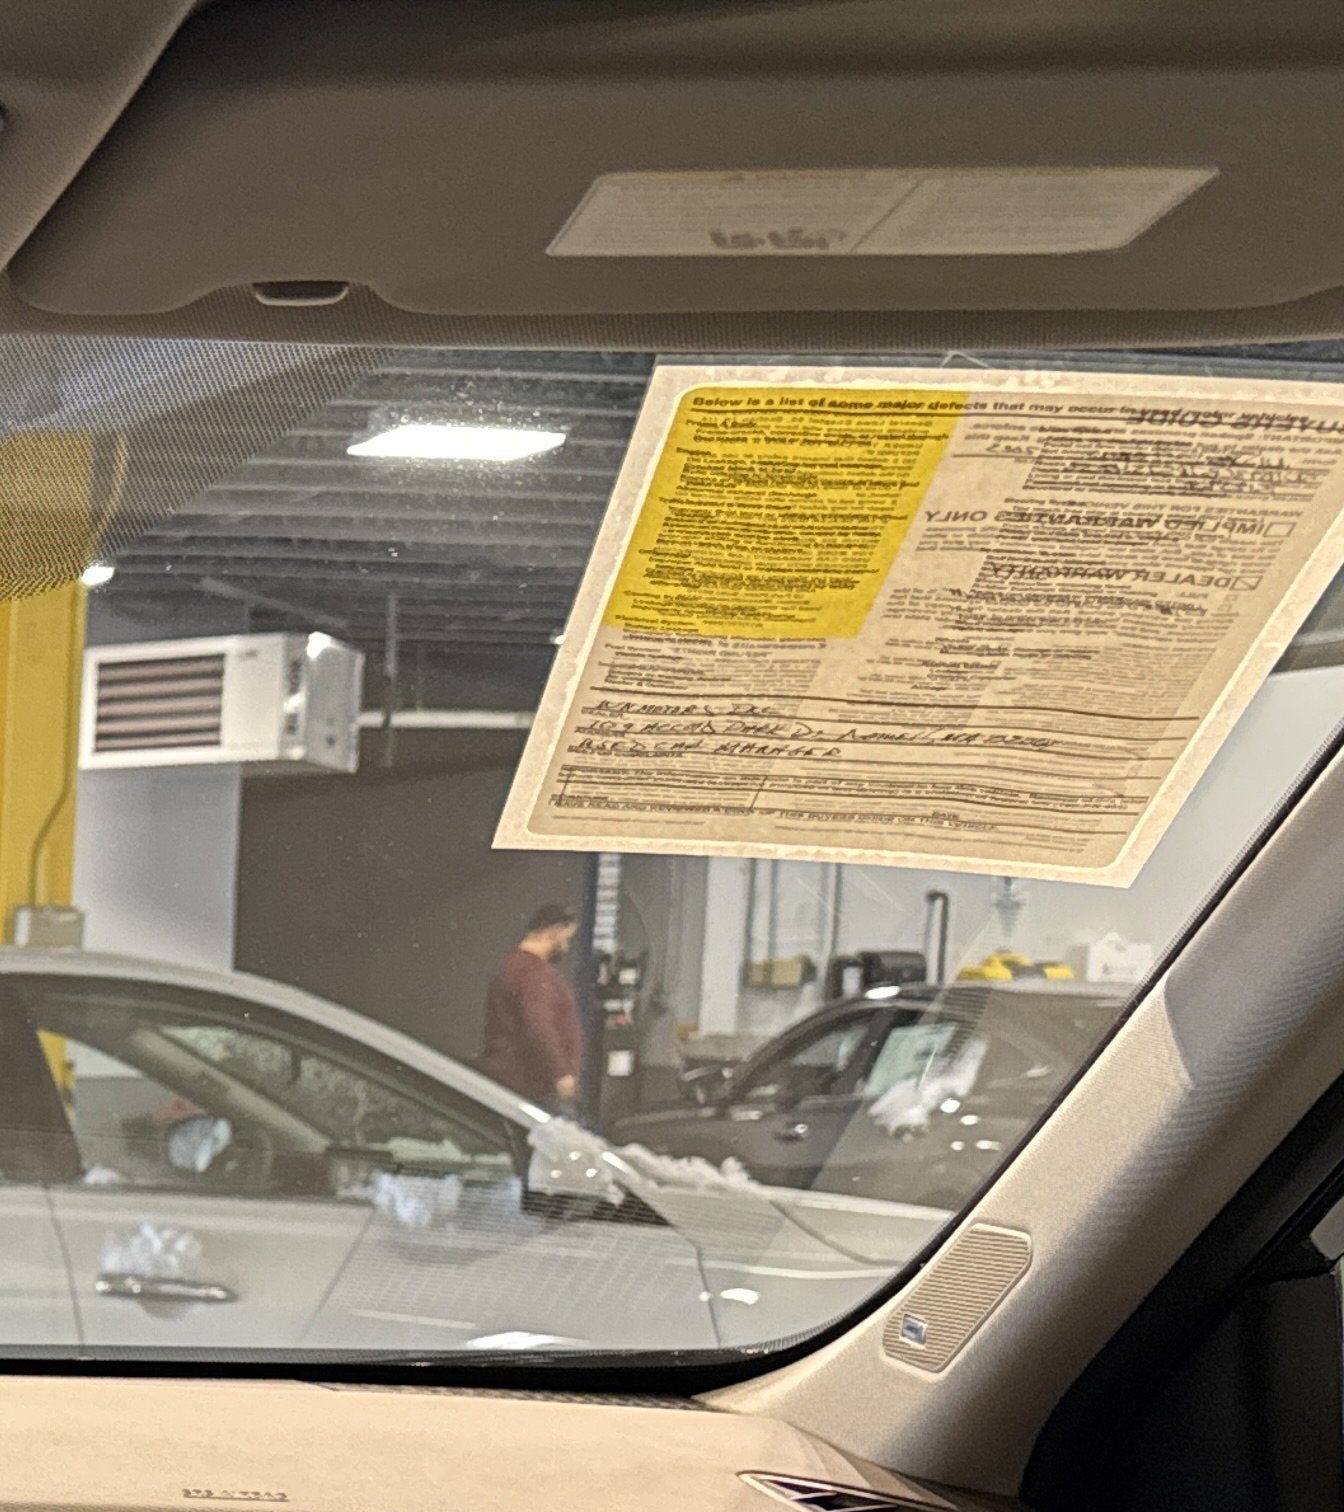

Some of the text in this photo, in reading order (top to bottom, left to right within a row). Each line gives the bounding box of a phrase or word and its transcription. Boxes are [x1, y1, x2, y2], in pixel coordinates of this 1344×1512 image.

[692, 396, 743, 407] Below
[746, 397, 761, 406] is
[765, 398, 775, 406] a
[778, 396, 805, 406] list
[808, 397, 827, 408] of
[828, 400, 874, 410] some
[877, 400, 925, 412] major
[927, 400, 988, 411] defects
[993, 401, 1025, 412] that
[1029, 403, 1063, 415] may
[1068, 405, 1114, 415] occur
[1119, 406, 1135, 415] in
